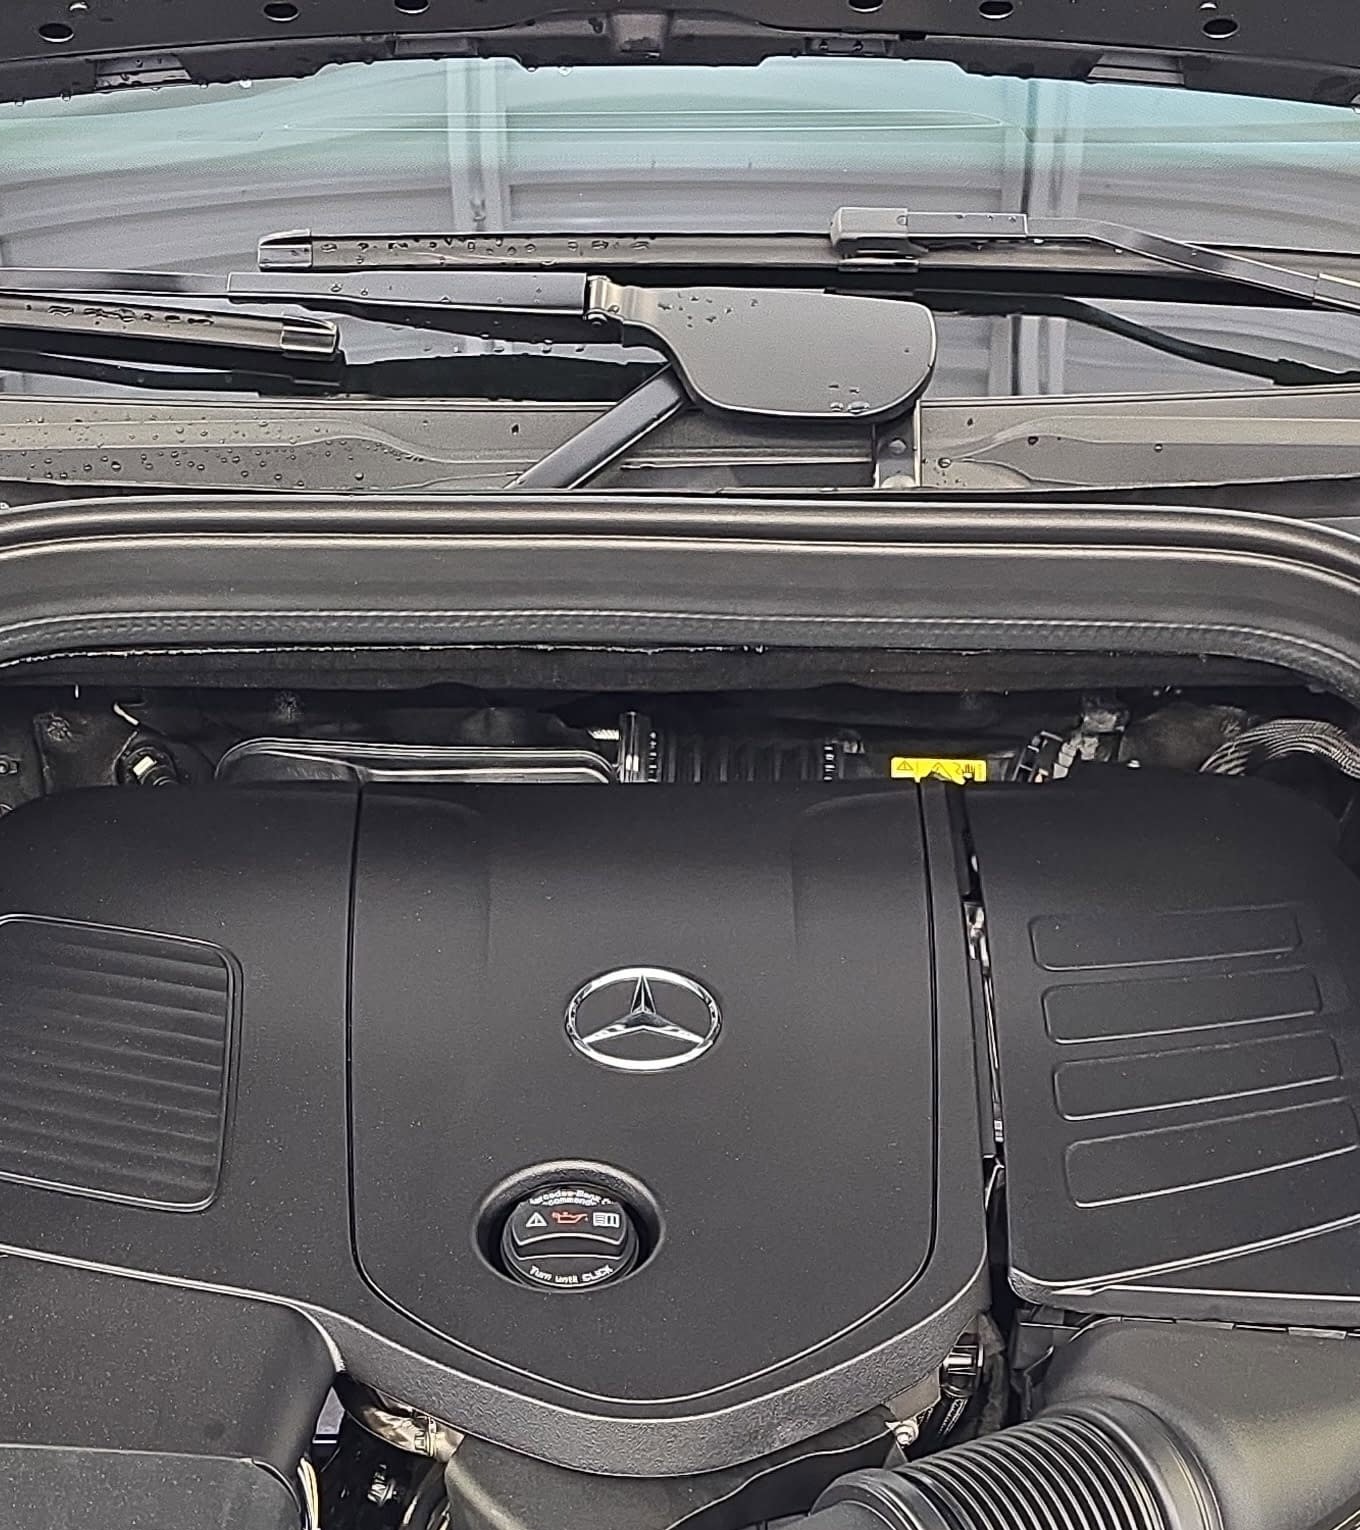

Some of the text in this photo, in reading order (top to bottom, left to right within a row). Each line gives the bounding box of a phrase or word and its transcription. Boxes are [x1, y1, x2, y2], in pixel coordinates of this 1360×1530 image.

[530, 1265, 613, 1284] Turn until CLICK
